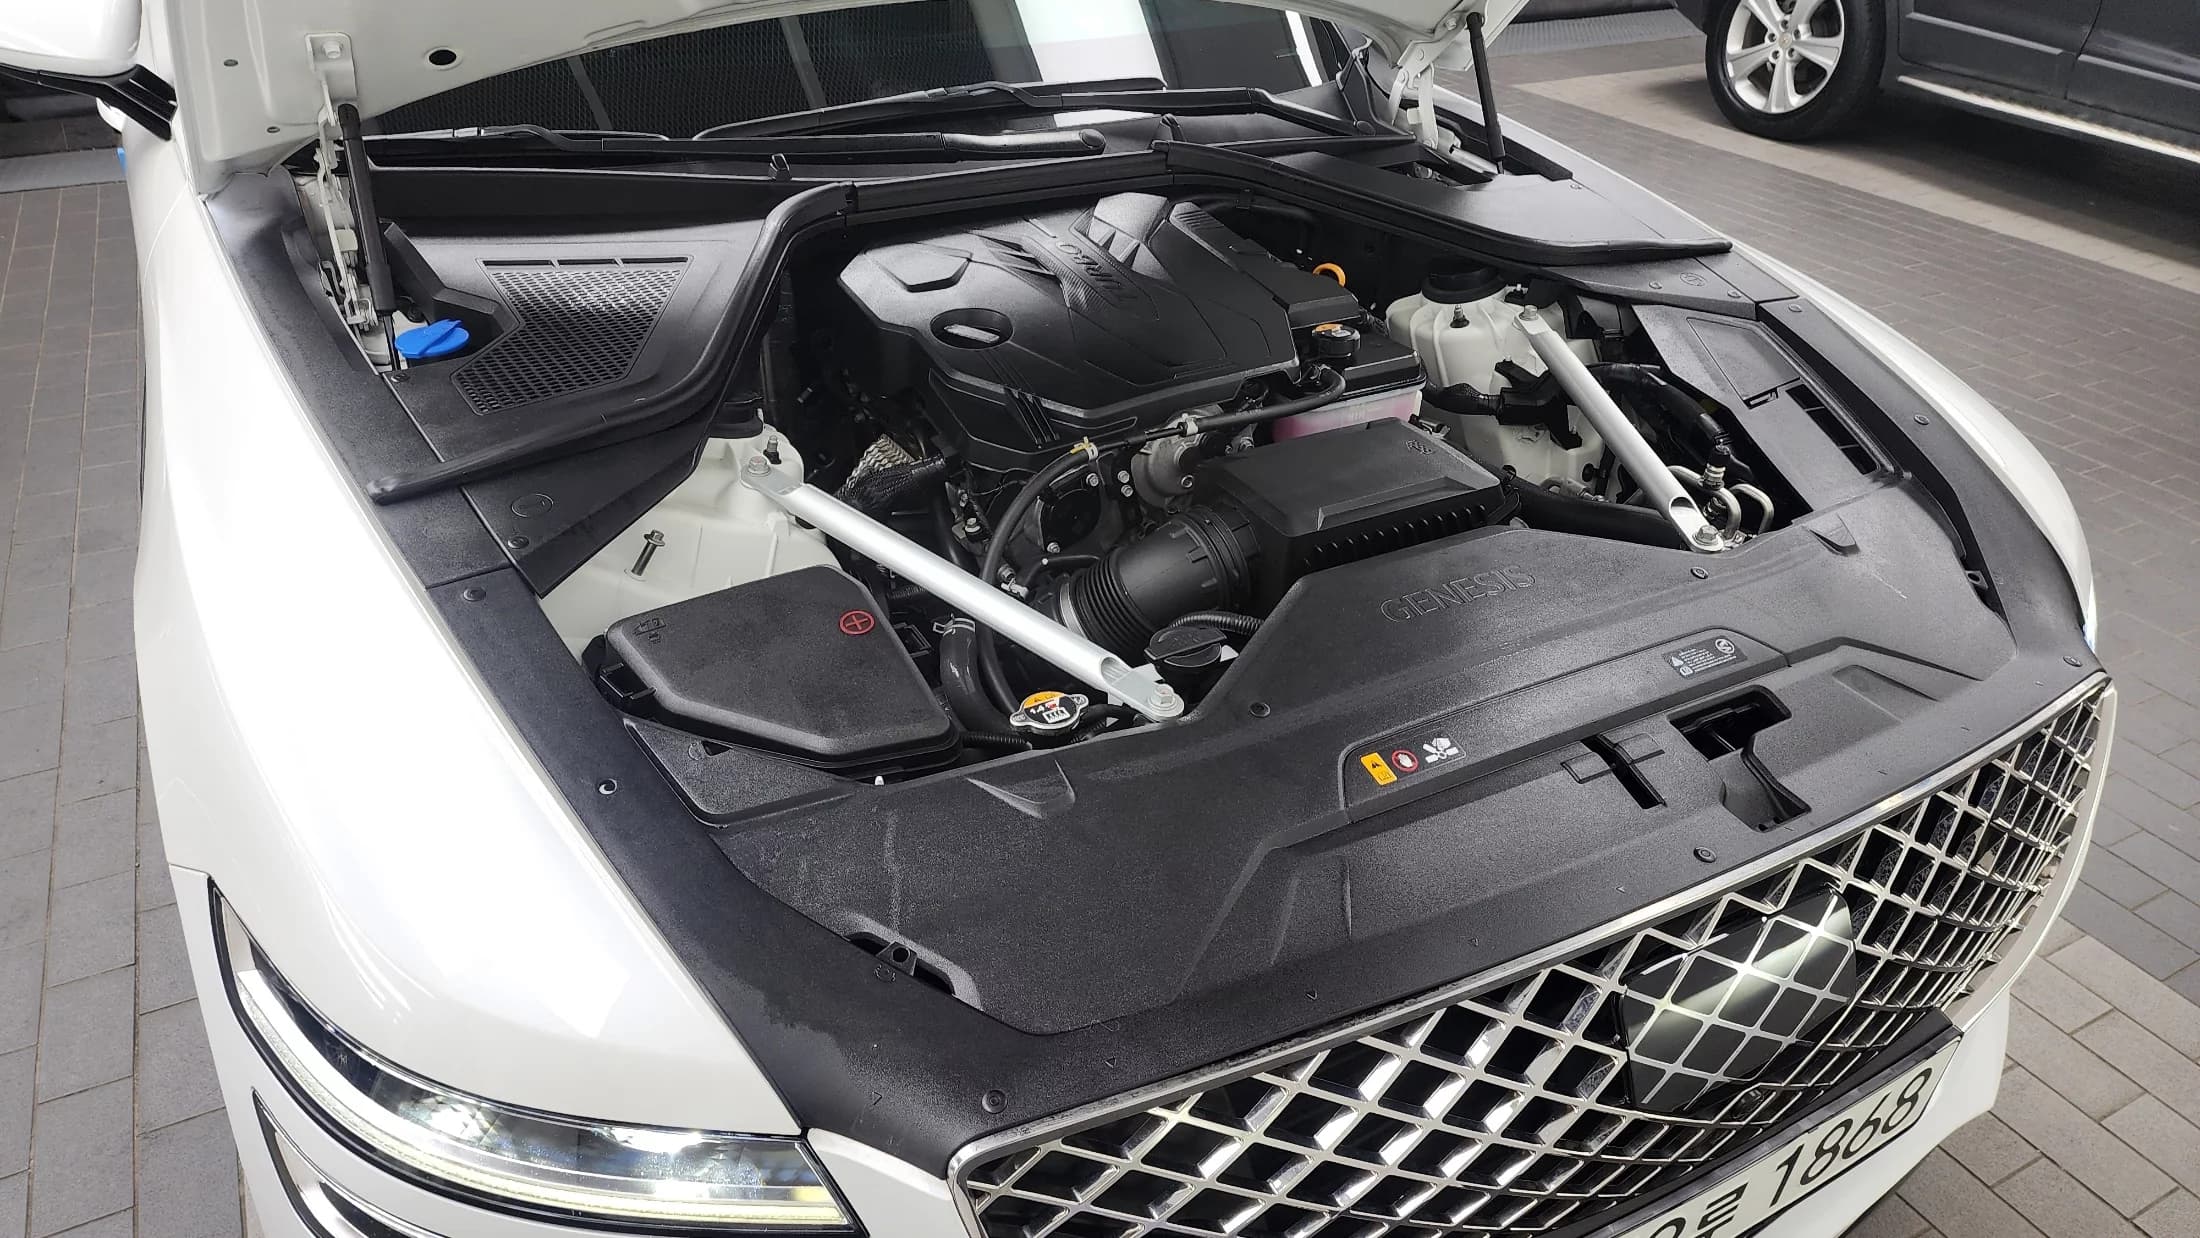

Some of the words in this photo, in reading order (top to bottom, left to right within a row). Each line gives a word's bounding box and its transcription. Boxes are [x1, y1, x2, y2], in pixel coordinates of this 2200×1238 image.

[1056, 241, 1138, 303] TURBO
[1380, 565, 1536, 623] GENESIS
[1769, 1067, 1933, 1208] 1868
